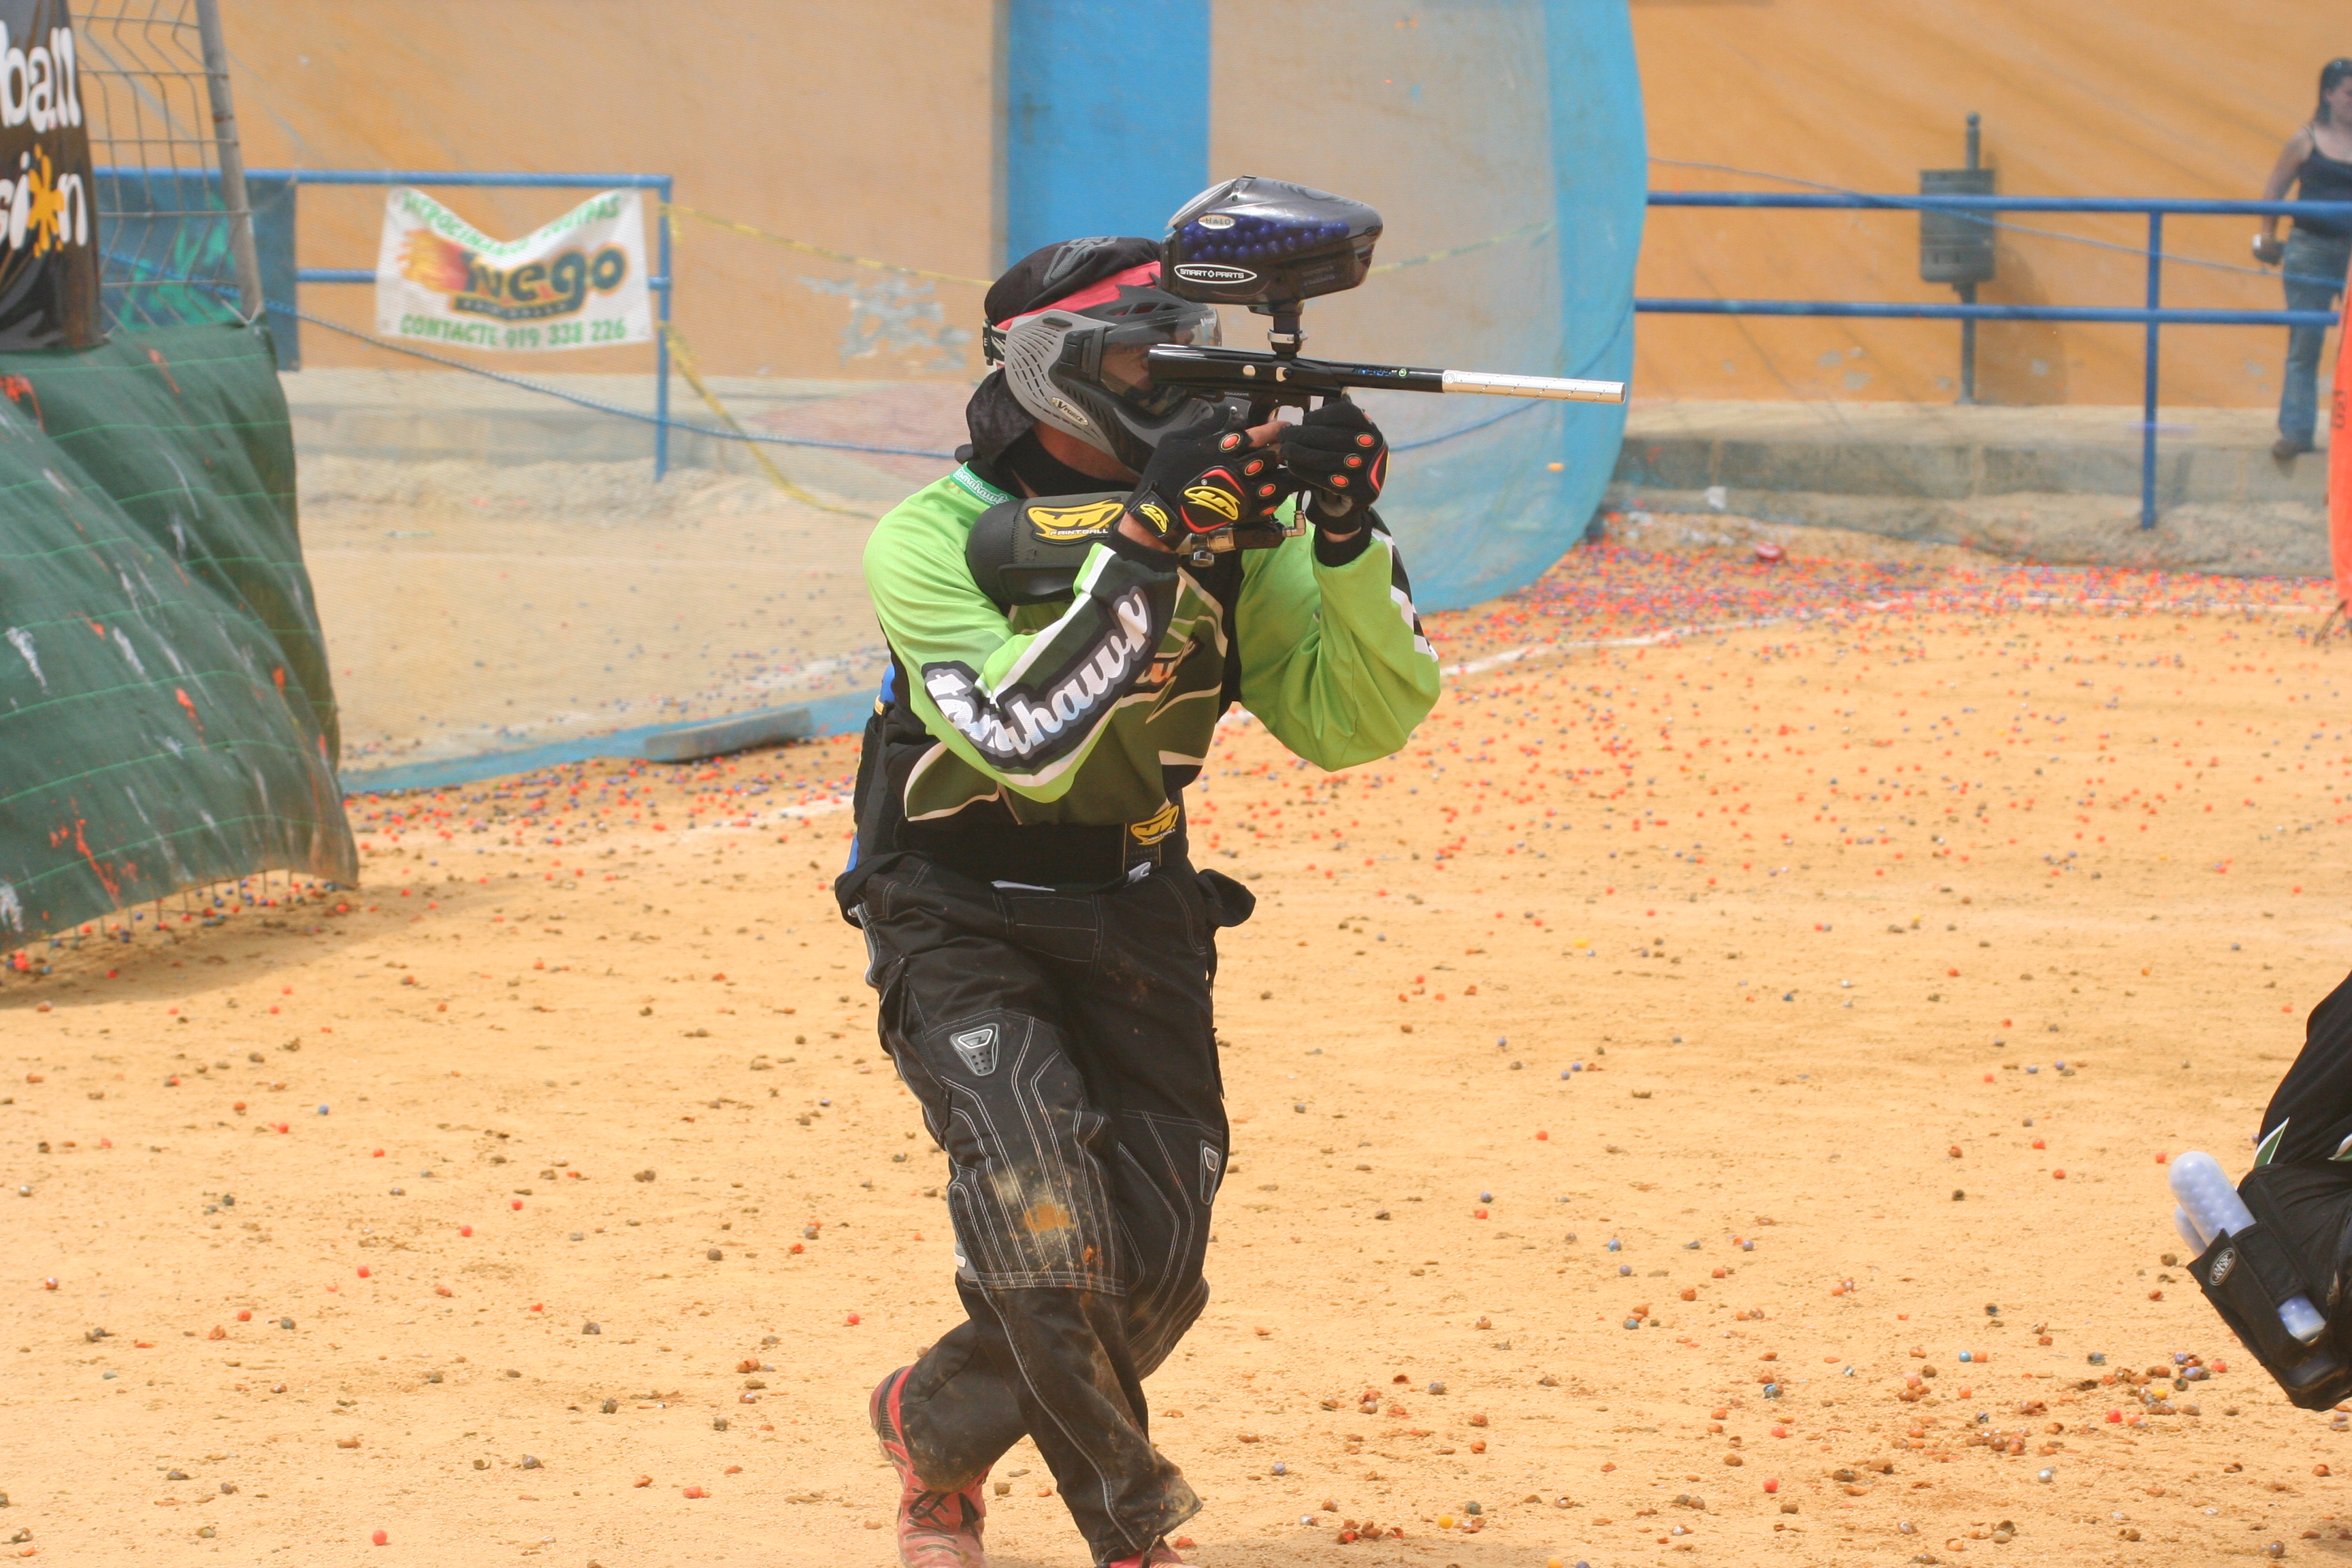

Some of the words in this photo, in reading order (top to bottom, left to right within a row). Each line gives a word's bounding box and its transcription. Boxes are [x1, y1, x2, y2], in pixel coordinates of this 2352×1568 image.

[1180, 268, 1208, 277] SMART
[1215, 271, 1245, 279] PARTS
[1049, 528, 1109, 536] PAINTBALL
